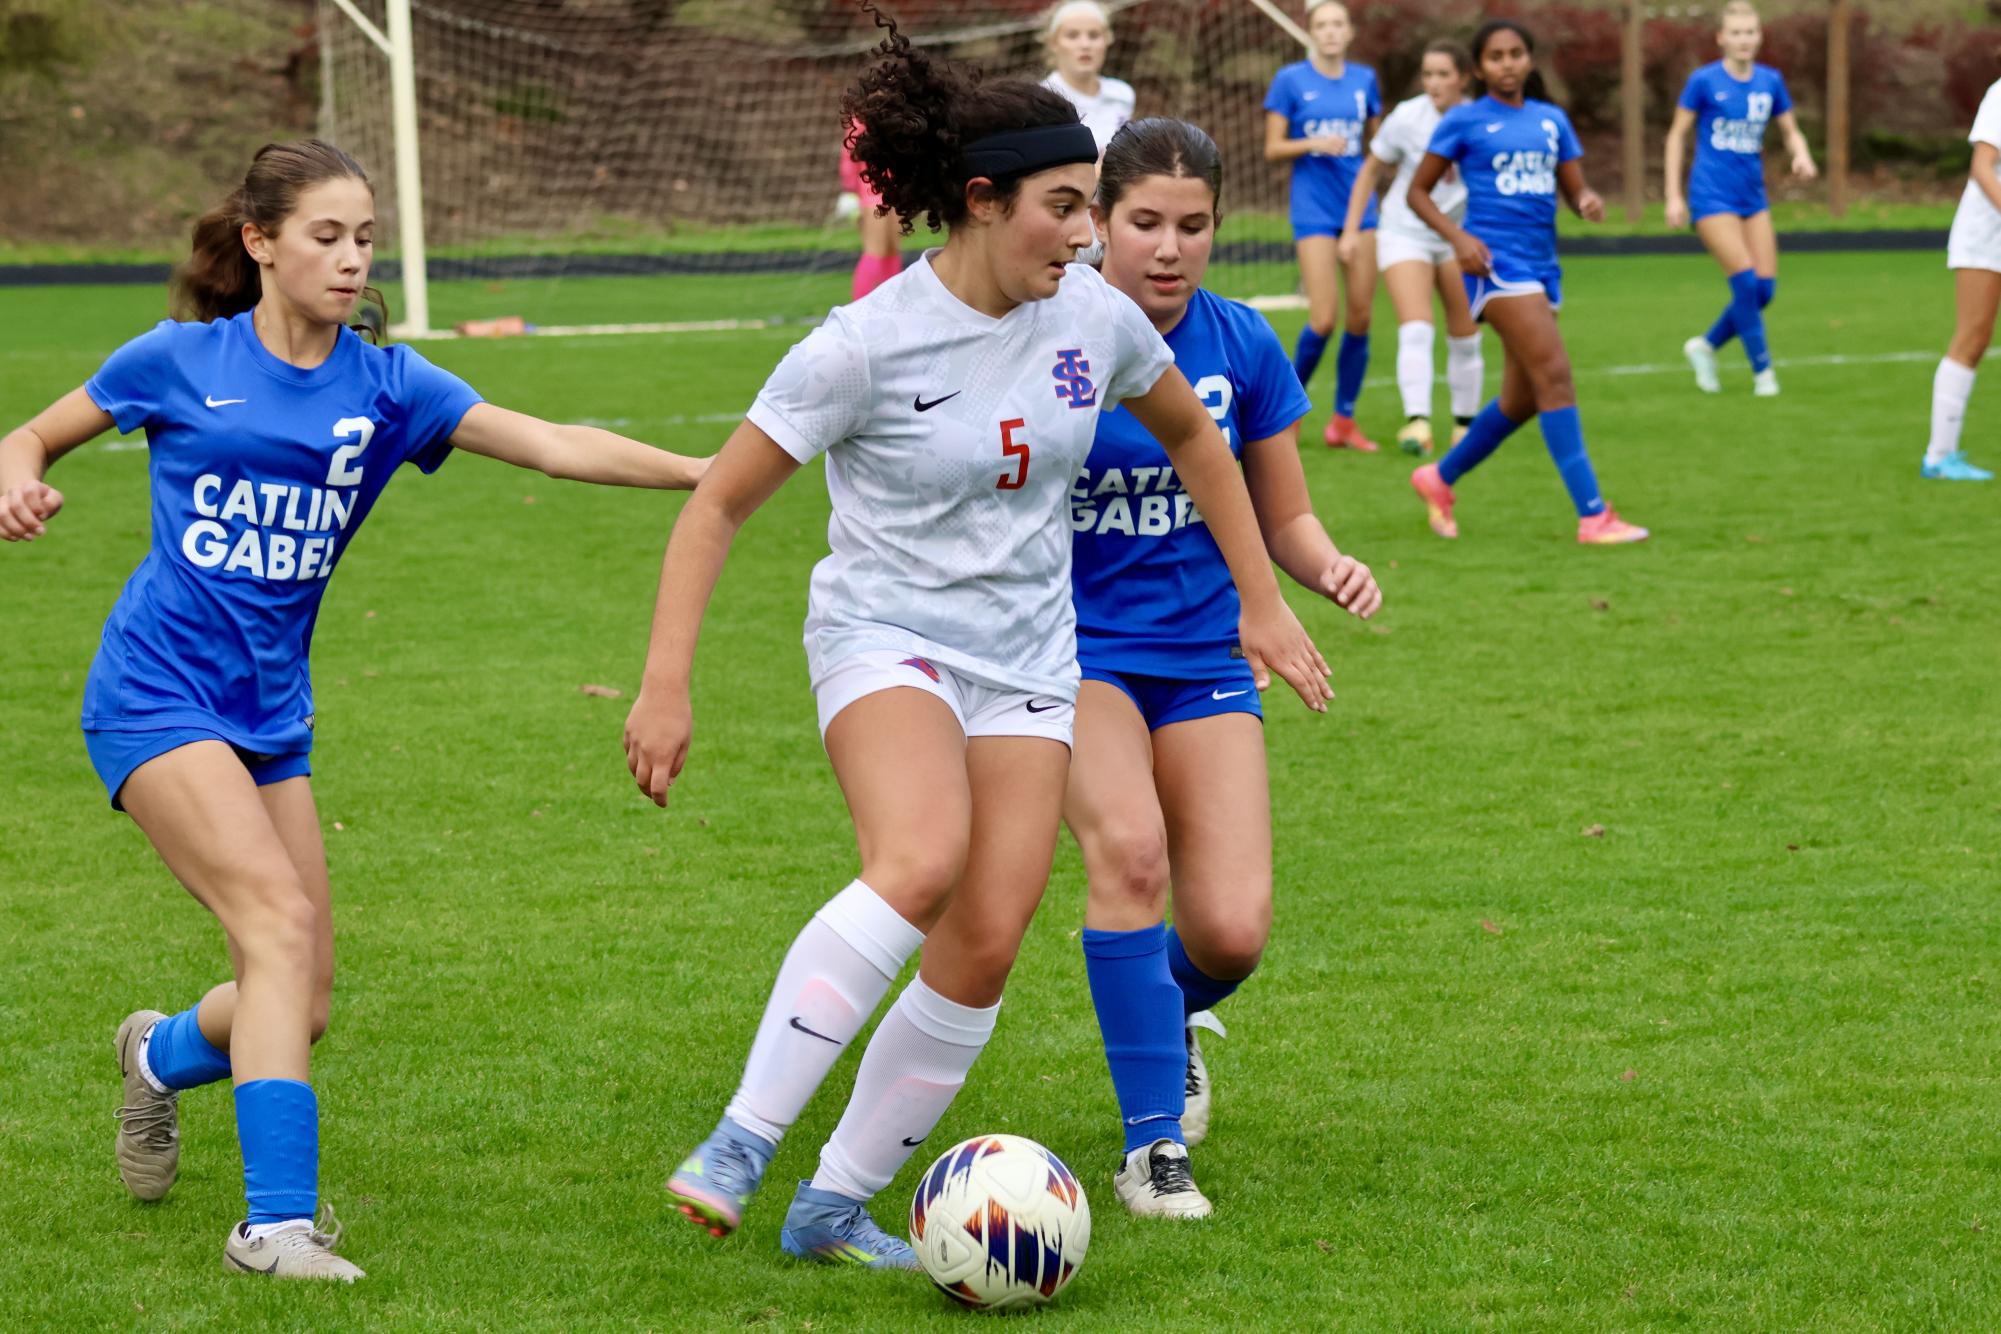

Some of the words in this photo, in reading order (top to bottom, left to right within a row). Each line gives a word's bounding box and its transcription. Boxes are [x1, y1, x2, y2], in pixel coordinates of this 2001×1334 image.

[325, 416, 375, 487] 2
[996, 417, 1030, 490] 5
[193, 473, 358, 532] CATLIN
[1071, 466, 1188, 498] CATL
[1072, 494, 1204, 536] GABE
[182, 520, 336, 580] GABEL
